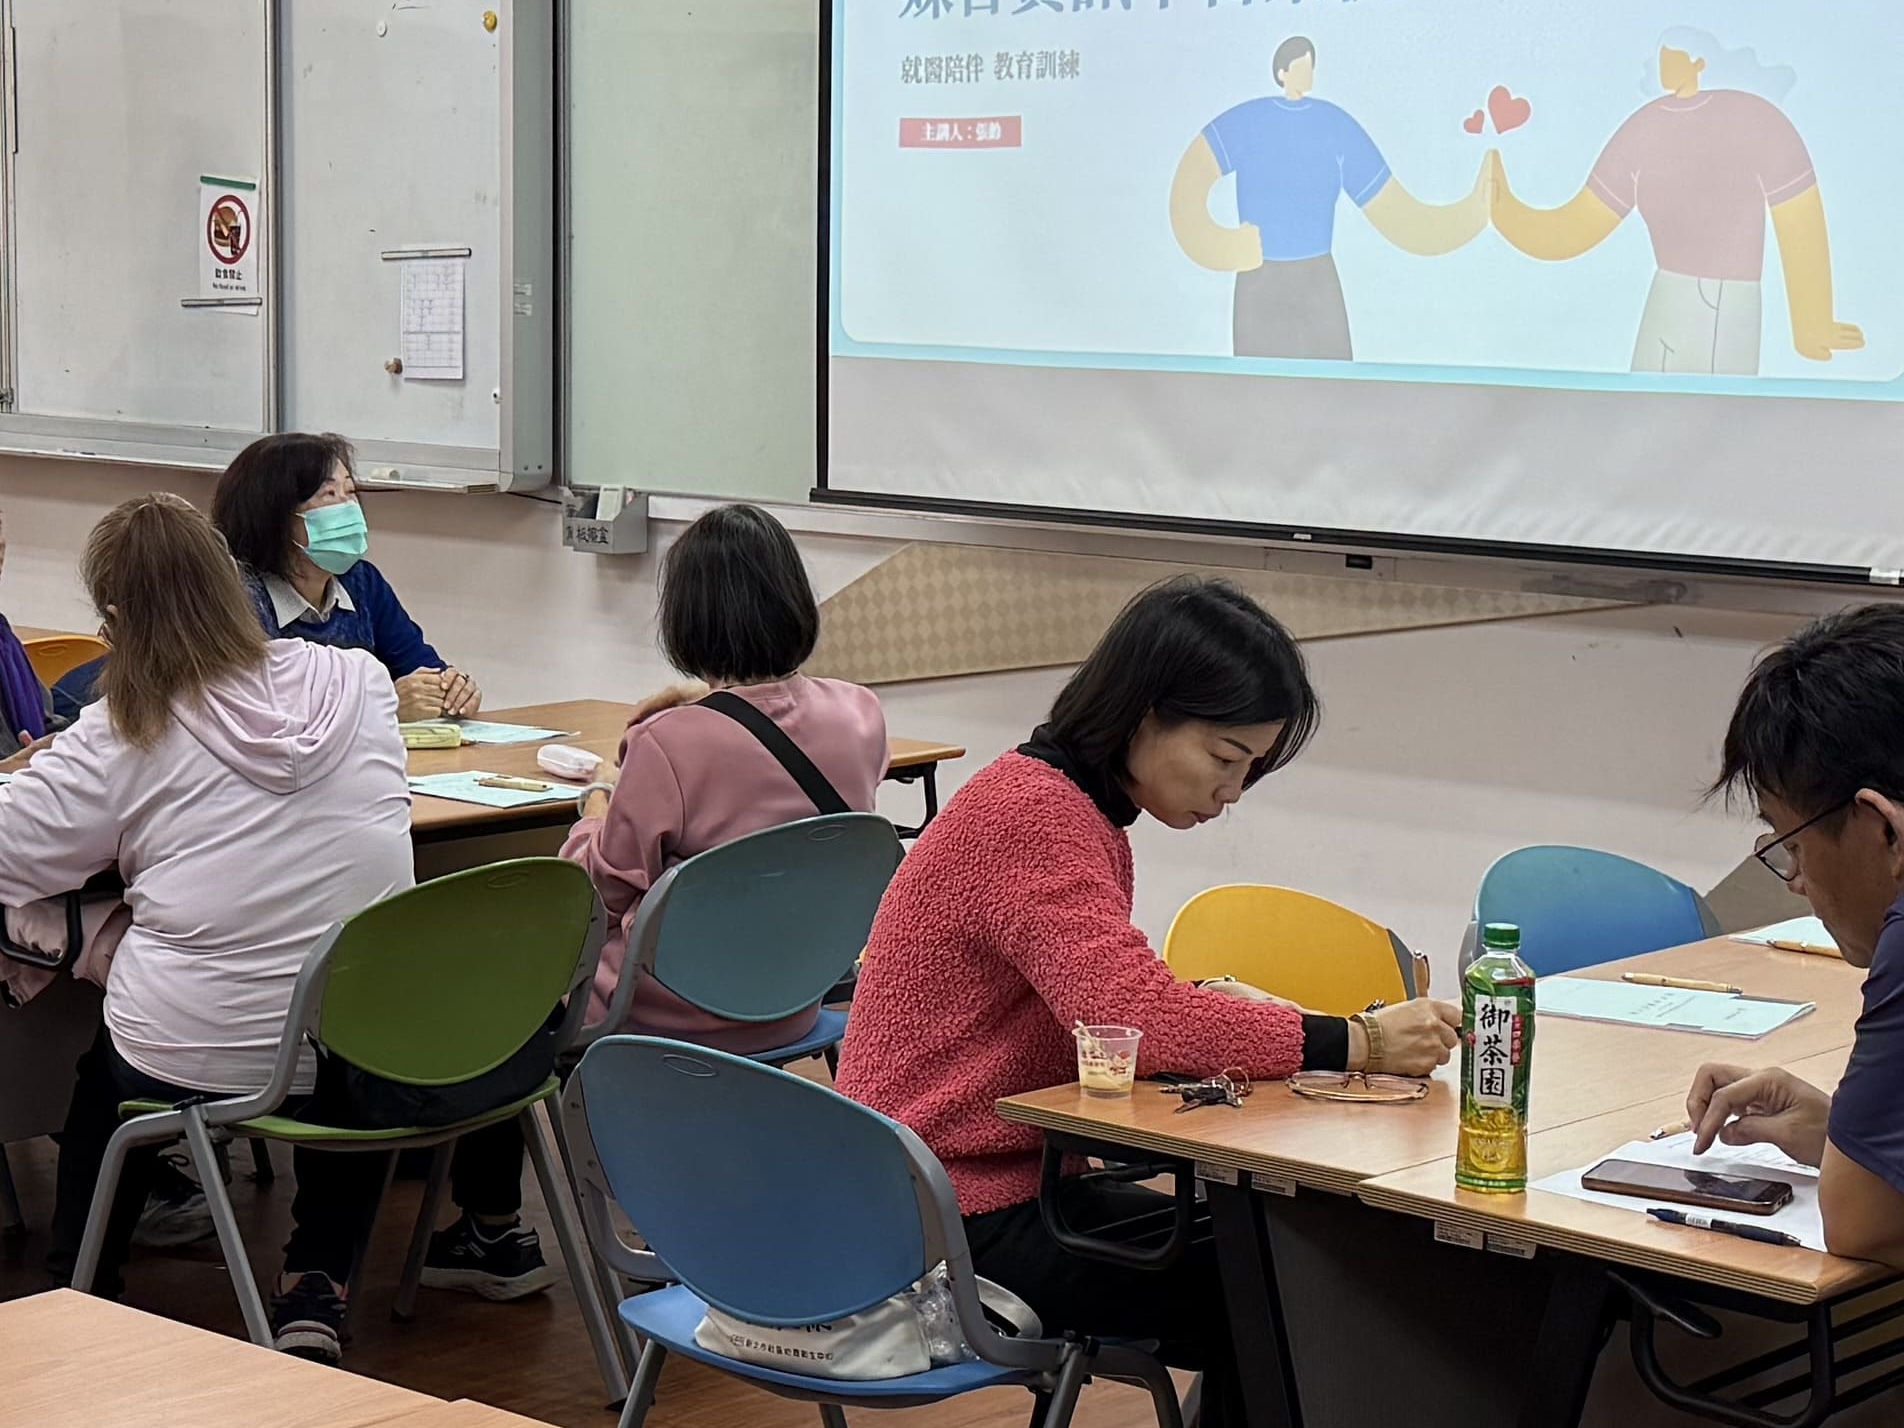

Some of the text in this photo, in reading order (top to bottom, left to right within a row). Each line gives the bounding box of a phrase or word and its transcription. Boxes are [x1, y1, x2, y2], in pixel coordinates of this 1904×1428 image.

[900, 49, 1080, 84] 就醫陪伴 教育訓練
[1479, 1003, 1511, 1098] 御茶園
